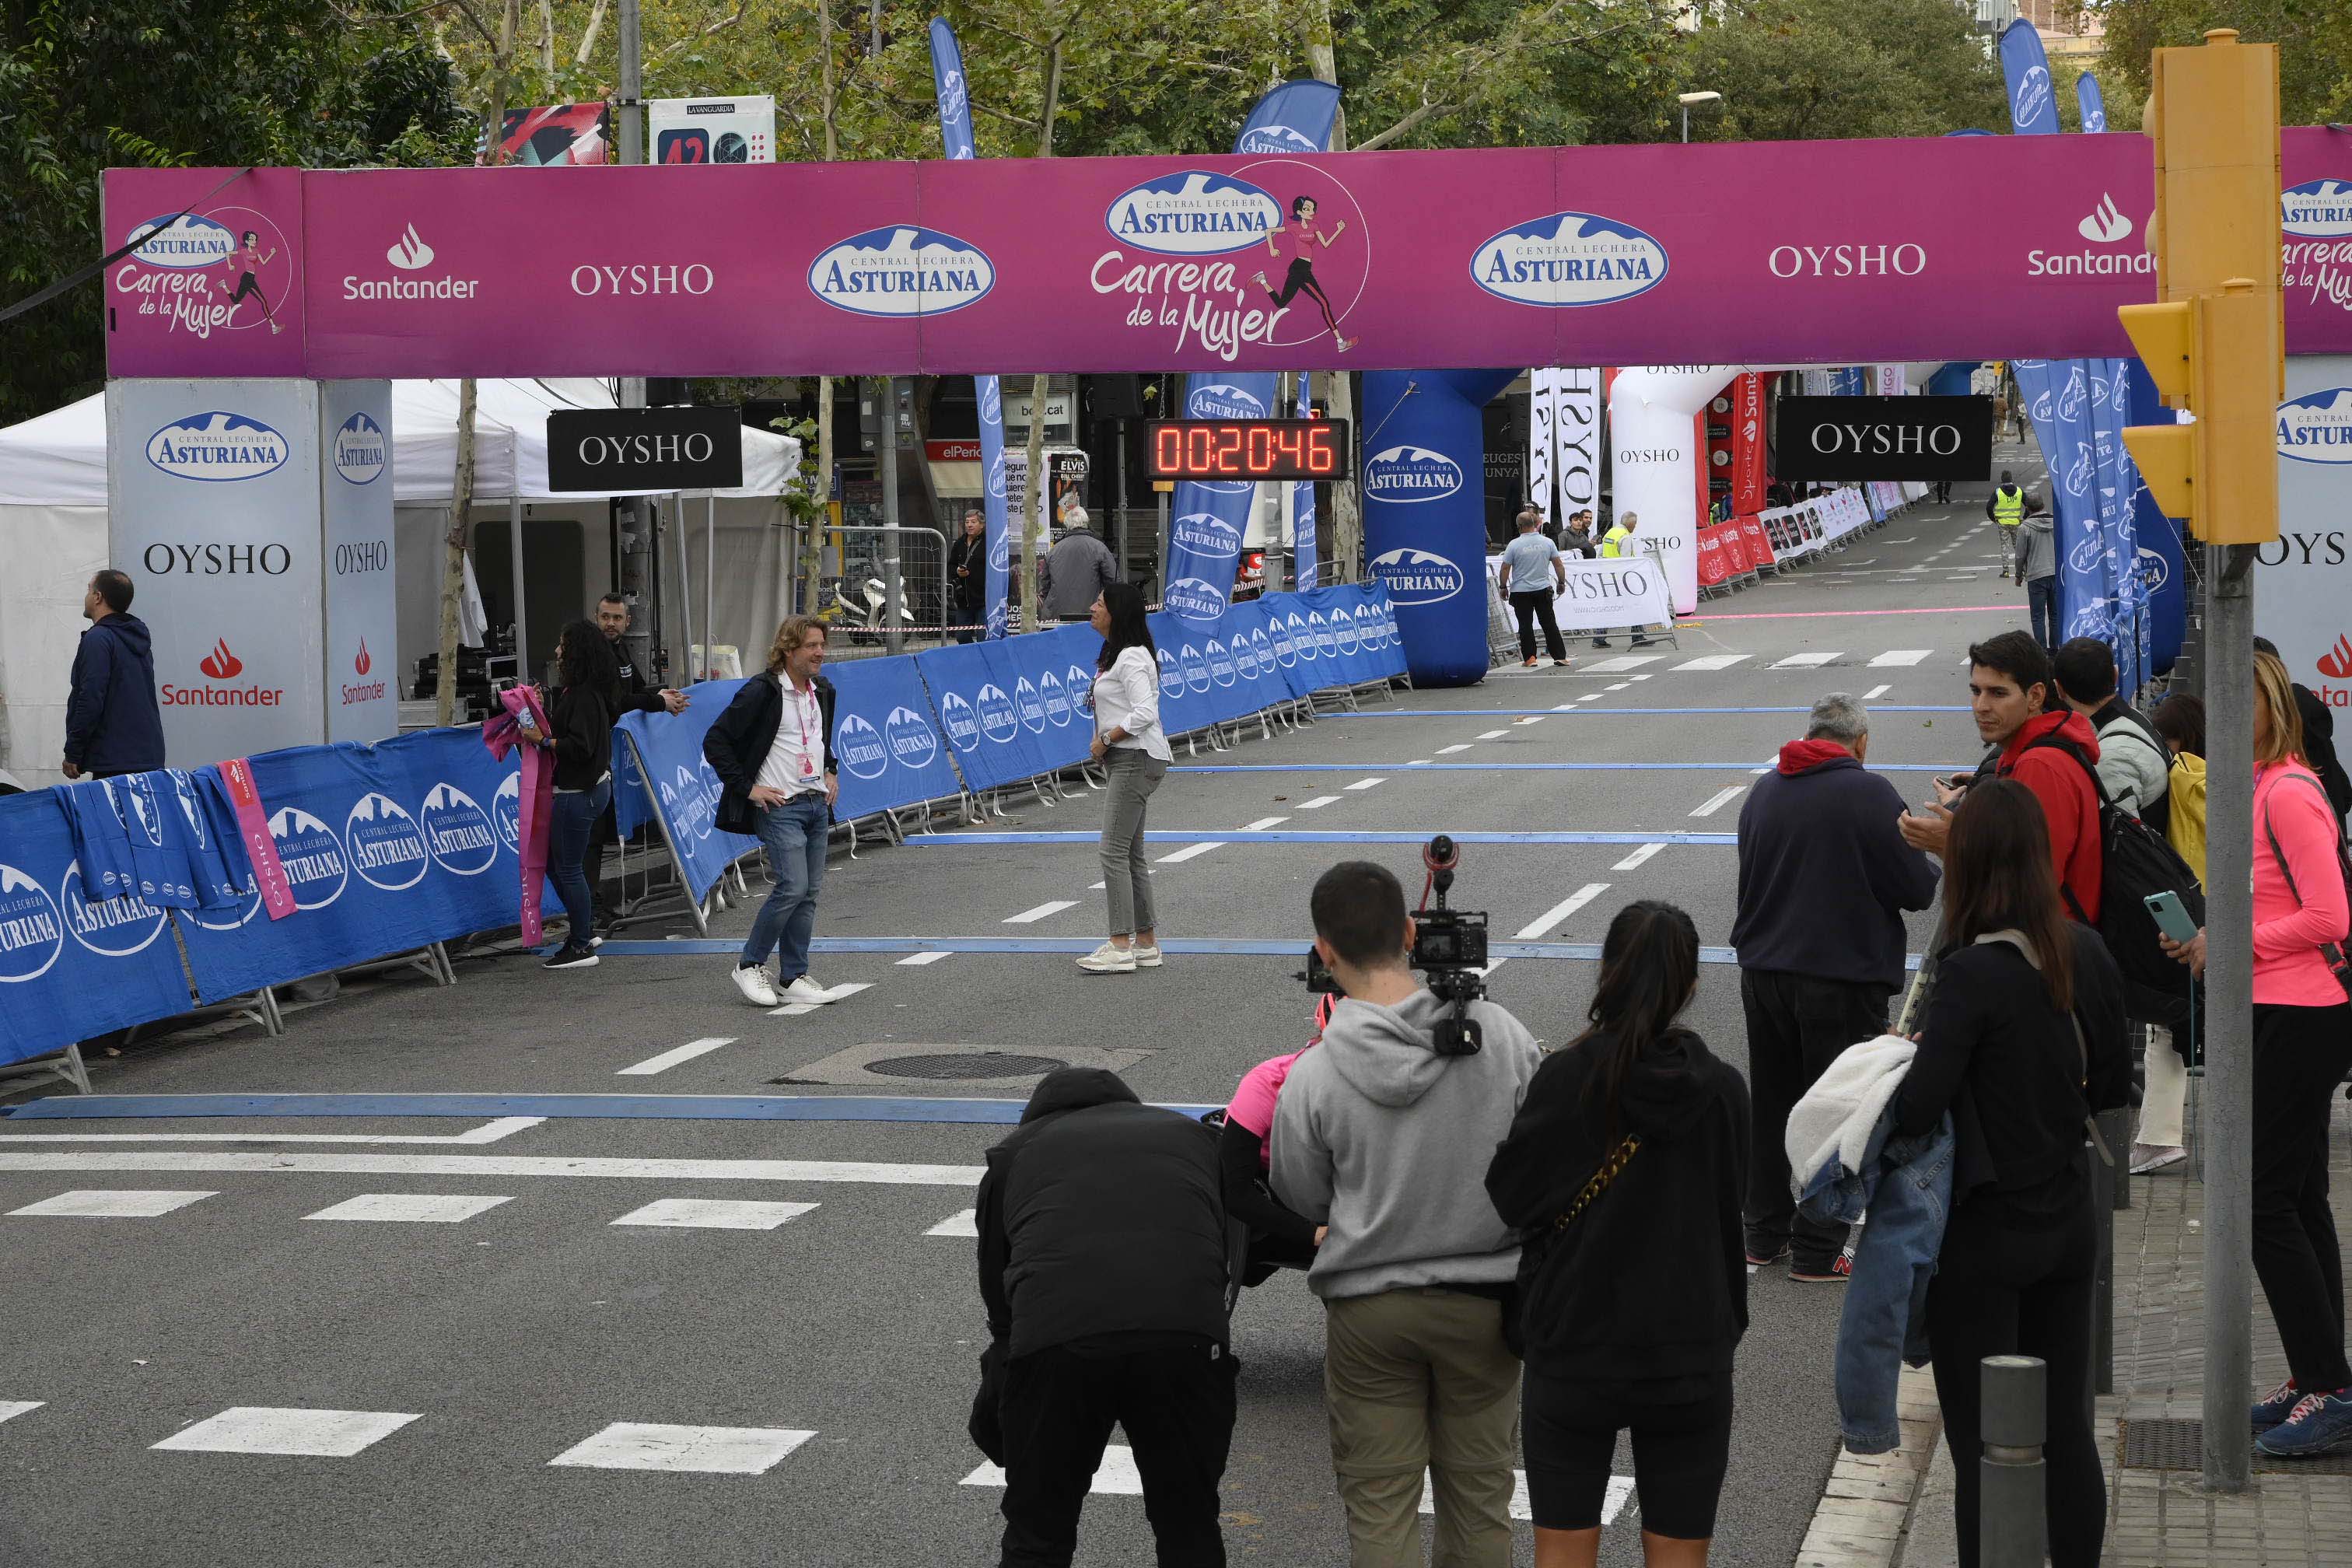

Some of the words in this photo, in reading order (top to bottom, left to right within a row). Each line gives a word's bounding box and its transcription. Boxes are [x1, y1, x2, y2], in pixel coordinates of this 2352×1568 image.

[1146, 199, 1202, 208] CENTRAL
[1207, 198, 1264, 208] LECHERA
[2280, 199, 2352, 223] ASTURIA
[1118, 202, 1269, 235] ASTURIANA
[851, 257, 910, 266] CENTRAL
[915, 256, 975, 265] LECHERA
[1516, 245, 1577, 255] CENTRAL
[1584, 243, 1647, 254] LECHERA
[1769, 243, 1927, 278] OYSHO
[2282, 241, 2352, 264] arrera
[1090, 250, 1237, 294] Carrera
[1485, 248, 1654, 283] ASTURIANA
[2028, 249, 2158, 276] Santand
[2300, 264, 2314, 287] la
[116, 264, 208, 294] Carrera
[343, 275, 479, 300] Santander
[571, 264, 714, 296] OYSHO
[821, 259, 982, 293] ASTURIANA
[138, 295, 156, 315] de
[159, 293, 172, 315] la
[169, 290, 243, 339] Mujer
[1126, 296, 1153, 327] de
[1159, 295, 1178, 327] la
[1174, 289, 1292, 362] Mujer
[1193, 394, 1260, 419] ASTURIANA
[1811, 423, 1962, 455] OYSHO
[2277, 417, 2352, 445] ASTUR
[158, 437, 278, 464] ASTURIANA
[338, 439, 383, 467] ASTURIANA
[579, 432, 713, 465] OYSHO
[943, 446, 982, 458] elPeri
[1156, 427, 1332, 471] 00:20:46
[1483, 453, 1521, 464] EUGES
[1620, 449, 1679, 464] OYSHO
[1005, 462, 1027, 471] egur
[1061, 460, 1085, 471] ELVIS
[1486, 467, 1520, 478] UNYA
[1367, 468, 1455, 490] ASTURIANA
[1174, 524, 1237, 551] ASTURIANA
[1643, 536, 1681, 551] SHO
[2255, 531, 2346, 566] OYS
[143, 543, 292, 575] OYSHO
[334, 540, 387, 575] OYSHO
[1371, 570, 1456, 590] TURIANA
[161, 684, 283, 706] Santander
[342, 680, 385, 705] Santander
[842, 740, 885, 765] ASTURIANA
[361, 827, 387, 838] CENTRAL
[433, 815, 456, 826] CENTRAL
[278, 845, 302, 855] ENTRAL
[303, 836, 333, 850] LECHERA
[354, 831, 425, 870] ASTURIANA
[428, 820, 494, 856] ASTURIANA
[280, 850, 345, 886] STURIANA
[12, 897, 44, 912] LECHERA
[0, 912, 59, 953] URIANA
